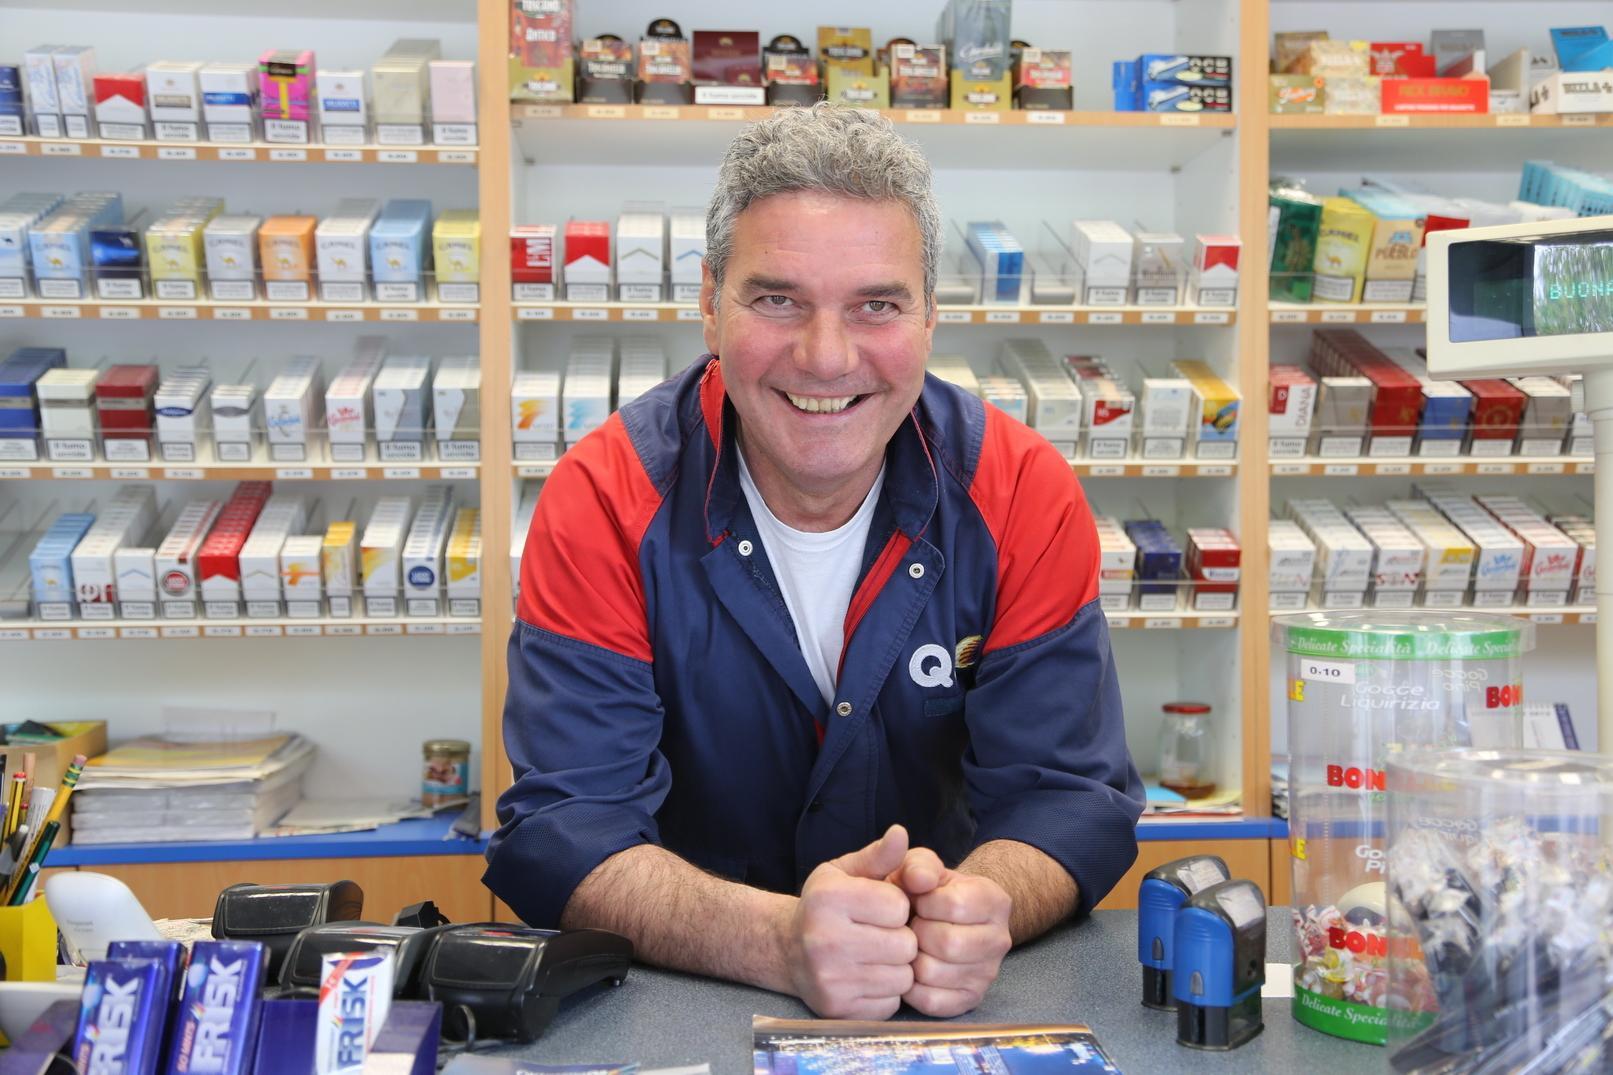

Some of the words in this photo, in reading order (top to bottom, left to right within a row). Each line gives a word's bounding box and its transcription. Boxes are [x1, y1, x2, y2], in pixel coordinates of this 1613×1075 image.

[1296, 387, 1313, 428] DIANA
[1298, 637, 1338, 652] Delicate
[908, 643, 953, 688] Q
[1309, 666, 1341, 677] 0.10
[1352, 680, 1424, 697] Gocce
[1340, 694, 1441, 711] Liquirizia
[190, 955, 244, 1074] FRISK
[1301, 993, 1342, 1018] Delicate
[337, 975, 369, 1070] FRISK
